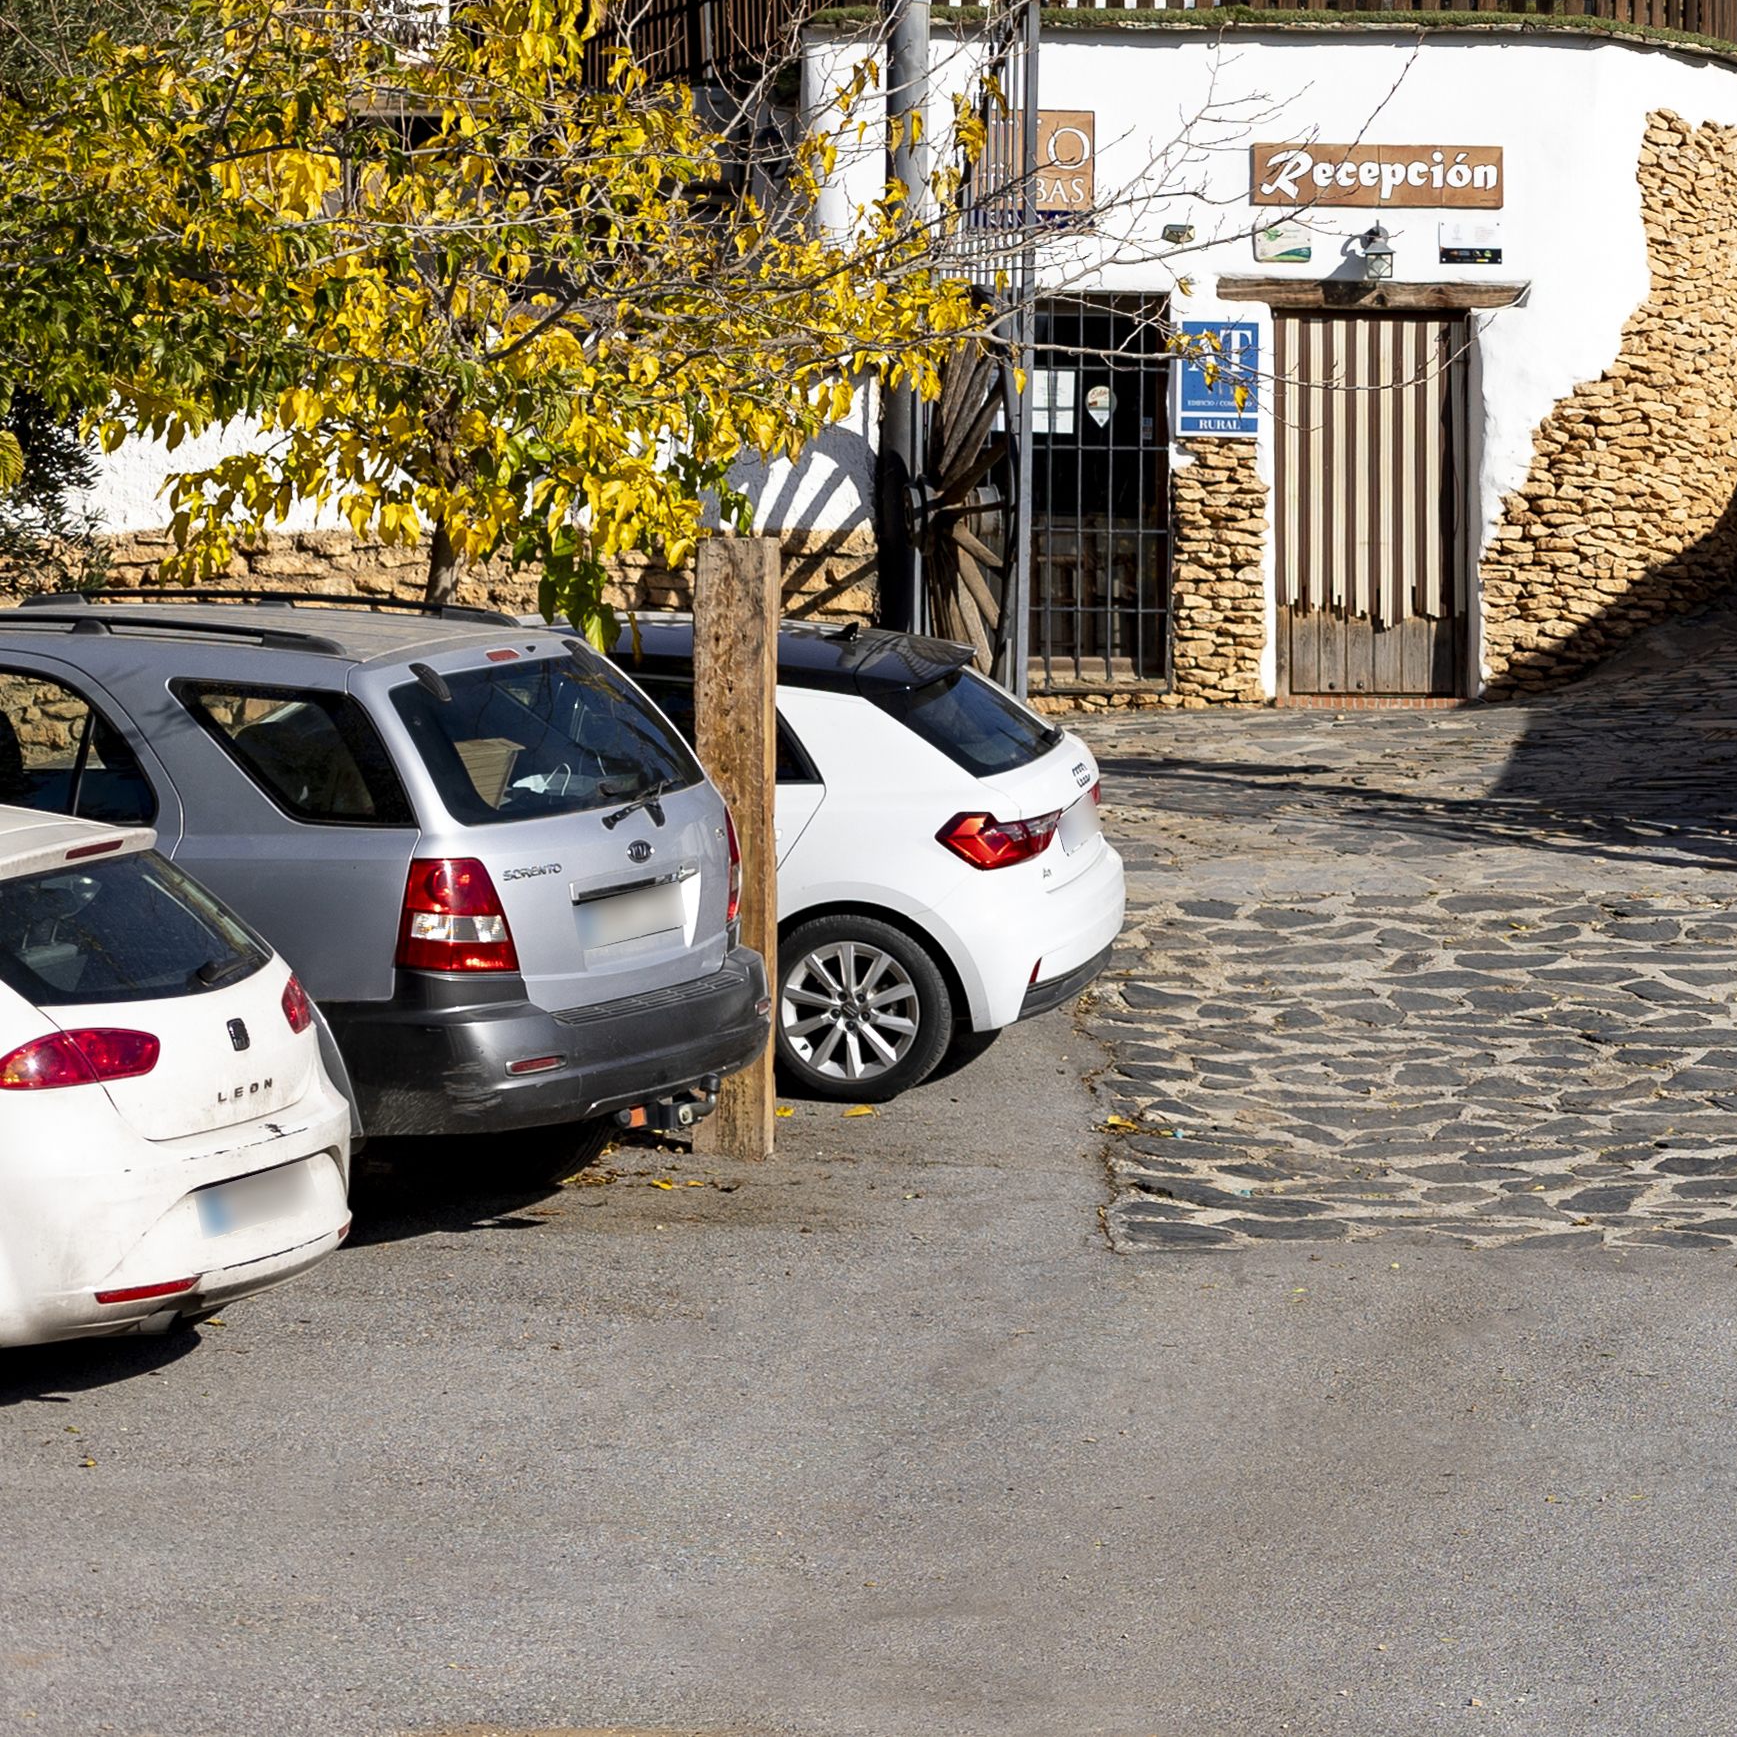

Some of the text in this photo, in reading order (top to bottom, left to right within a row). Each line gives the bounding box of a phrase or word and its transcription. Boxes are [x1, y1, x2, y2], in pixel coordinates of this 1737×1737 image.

[1259, 149, 1498, 200] Recepción
[1199, 419, 1241, 430] RURAL
[503, 863, 562, 881] SORENTO
[217, 1077, 273, 1103] LEON
